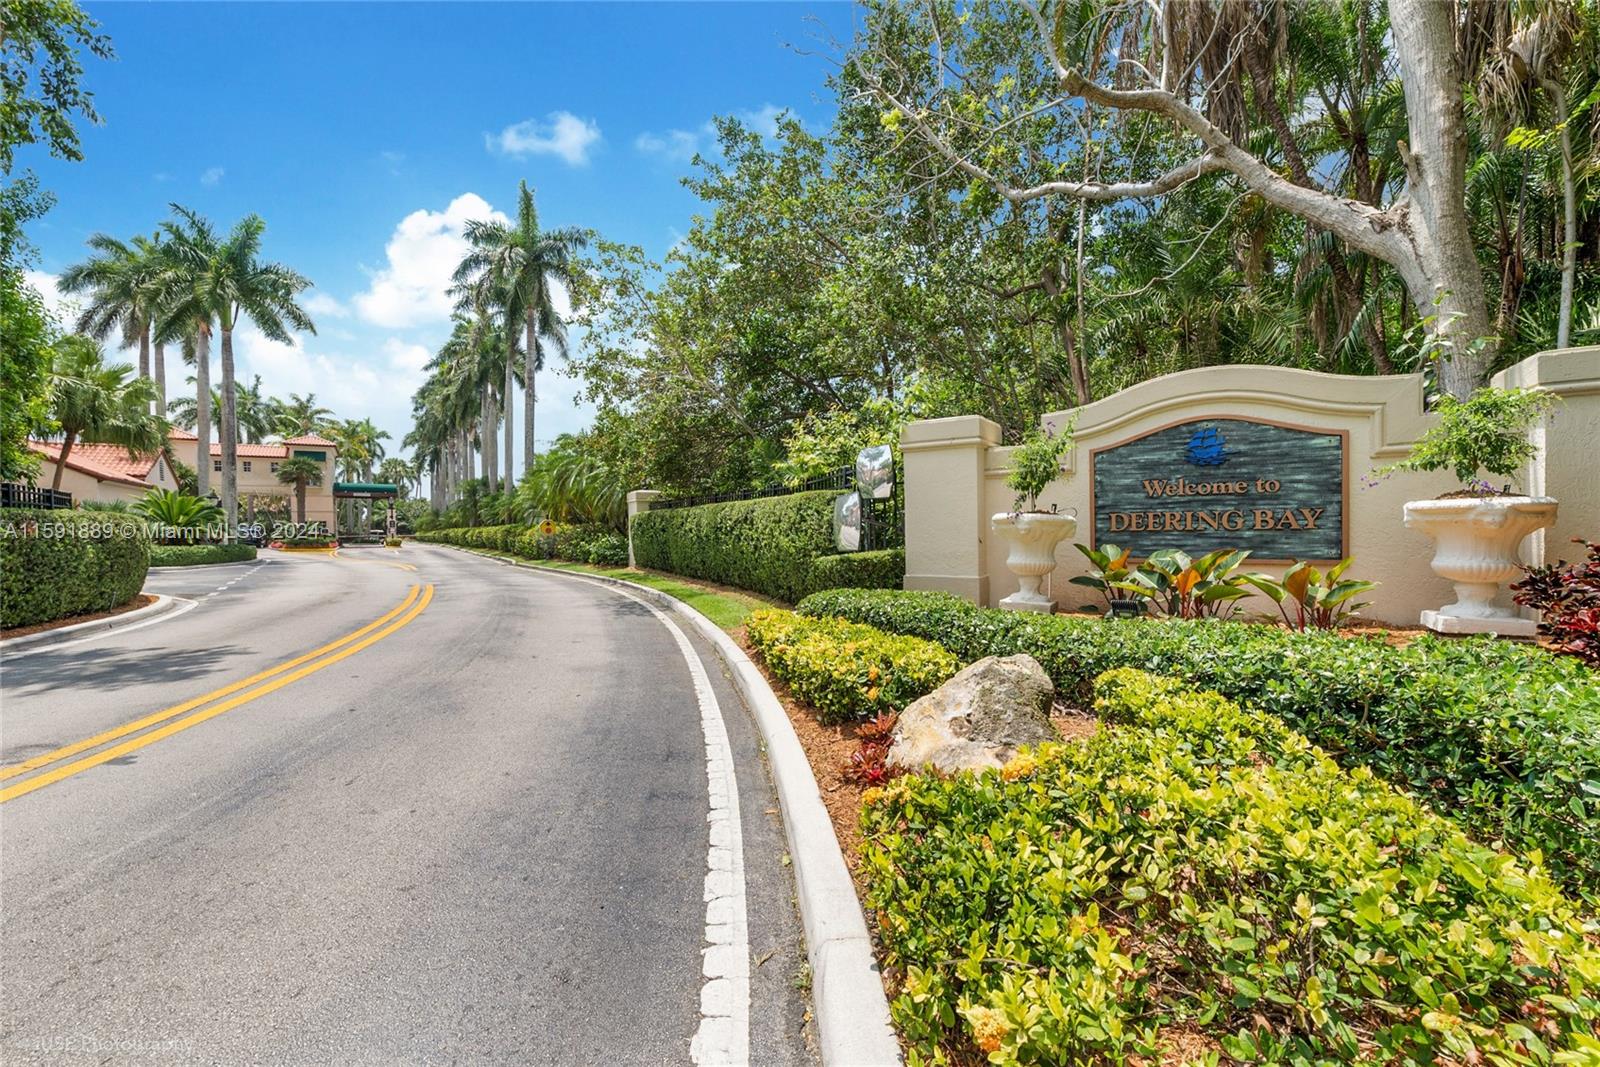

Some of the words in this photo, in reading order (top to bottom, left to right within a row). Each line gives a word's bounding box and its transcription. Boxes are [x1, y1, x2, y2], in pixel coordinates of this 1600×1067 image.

[1142, 477, 1248, 497] Welcome
[1256, 478, 1281, 494] to
[1109, 510, 1245, 532] DEERING
[1253, 507, 1324, 531] BAY
